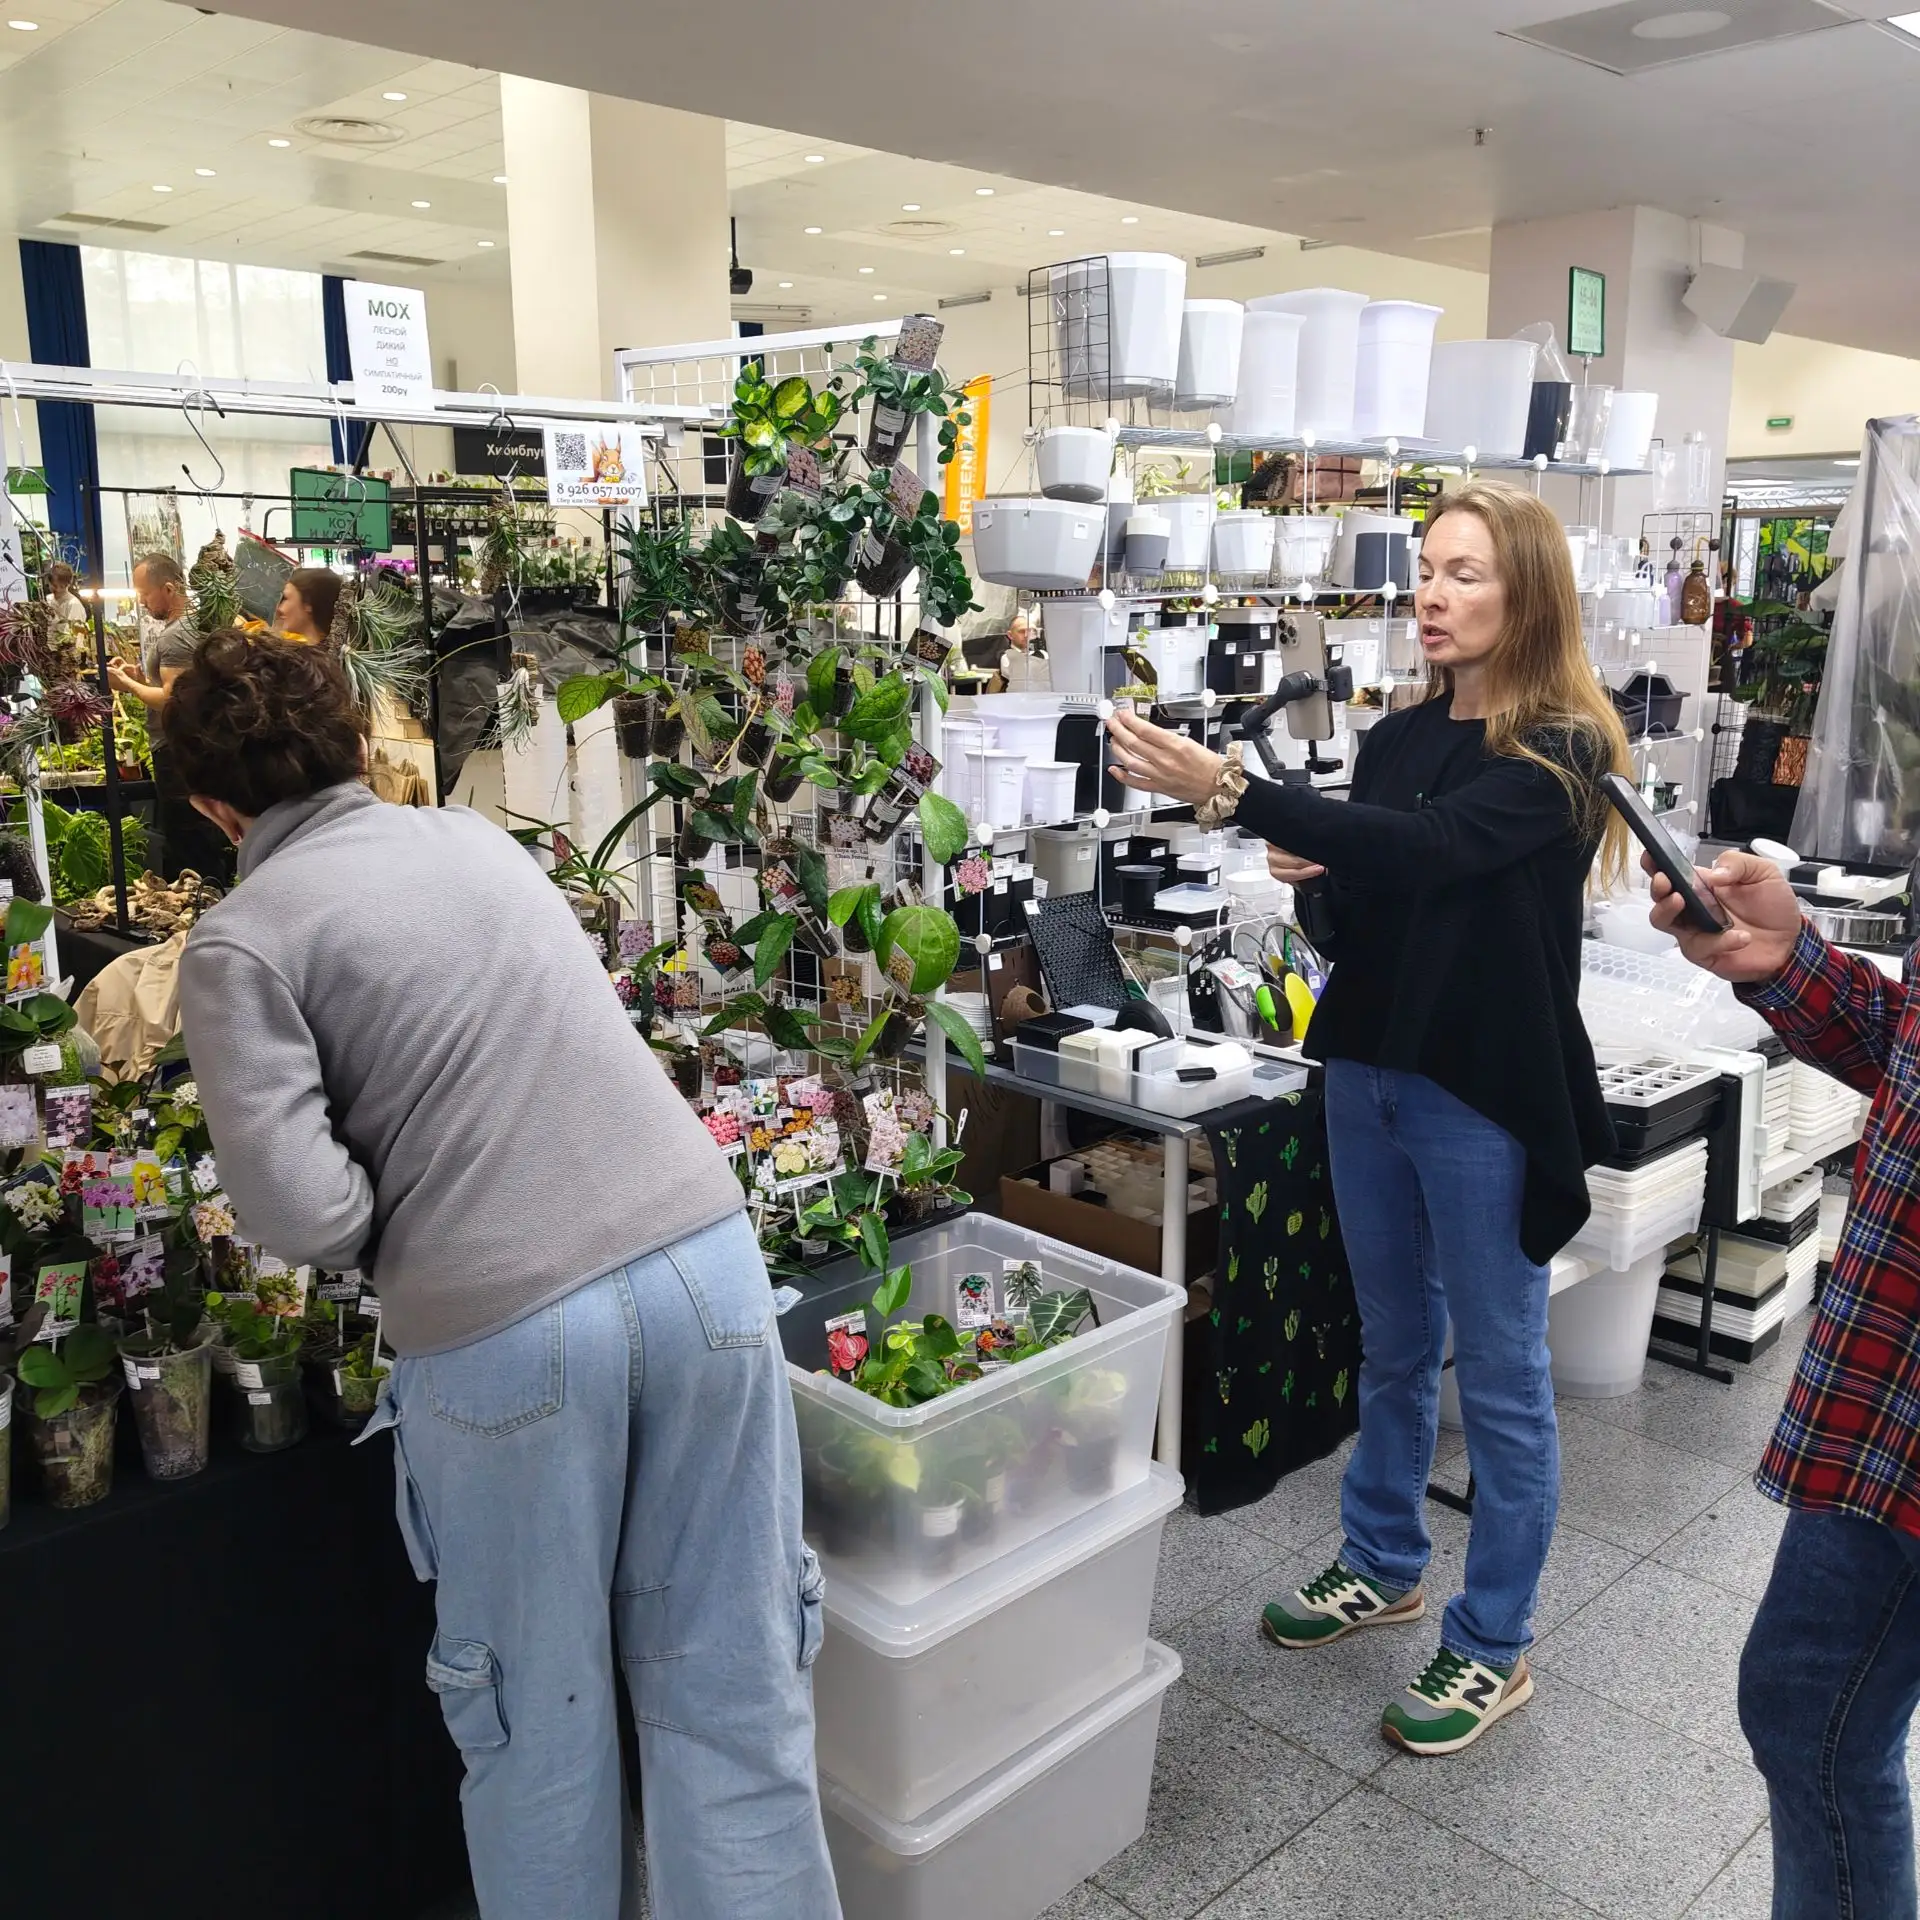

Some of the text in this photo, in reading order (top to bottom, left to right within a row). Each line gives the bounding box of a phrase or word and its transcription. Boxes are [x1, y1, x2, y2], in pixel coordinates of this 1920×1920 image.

[368, 299, 410, 320] МОХ
[373, 325, 407, 337] ЛЕСНОЙ
[376, 340, 406, 351] ДИКИЙ
[386, 357, 399, 367] НО
[364, 368, 423, 380] СИМПАТИЧНЫЙ
[556, 482, 641, 498] 8 926 057 1007
